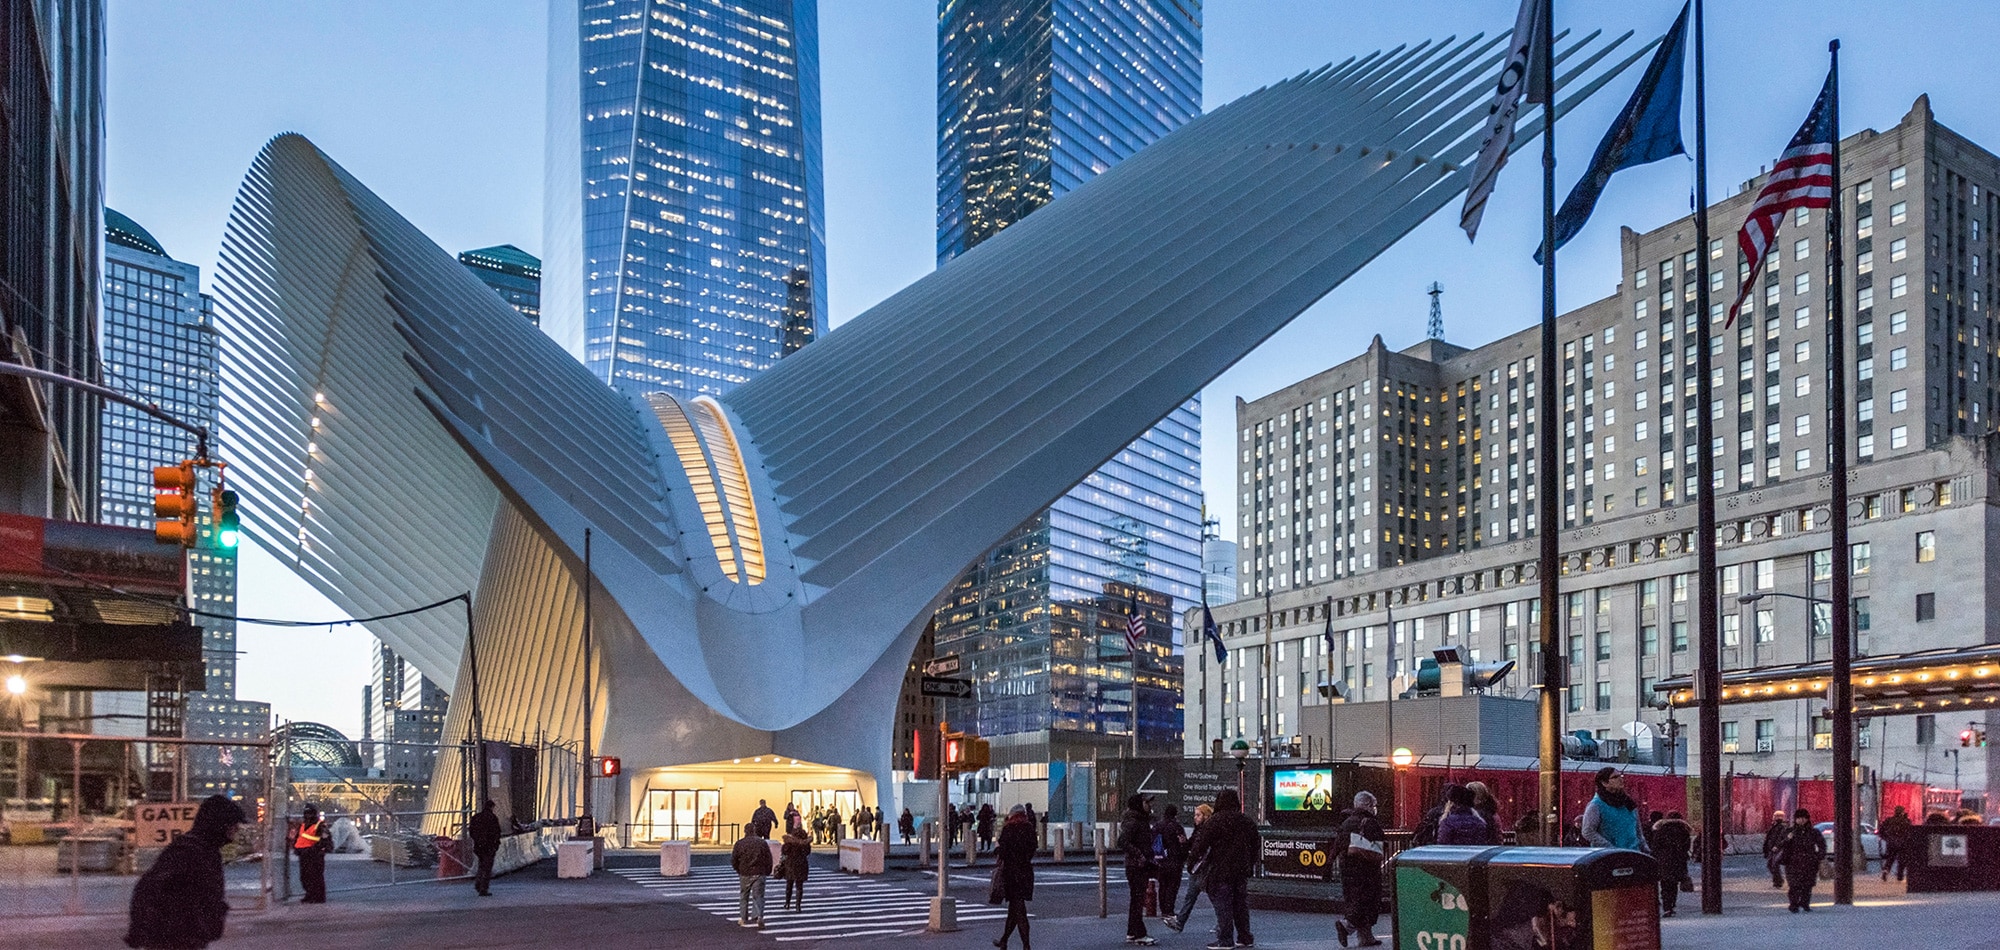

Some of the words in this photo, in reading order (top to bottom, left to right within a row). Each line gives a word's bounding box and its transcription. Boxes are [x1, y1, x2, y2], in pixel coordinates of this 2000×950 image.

[142, 808, 194, 821] GATE
[1264, 841, 1294, 849] Cortlandt
[1295, 841, 1316, 850] Street
[1264, 849, 1287, 857] Station
[1302, 853, 1310, 863] R
[1315, 854, 1324, 864] W
